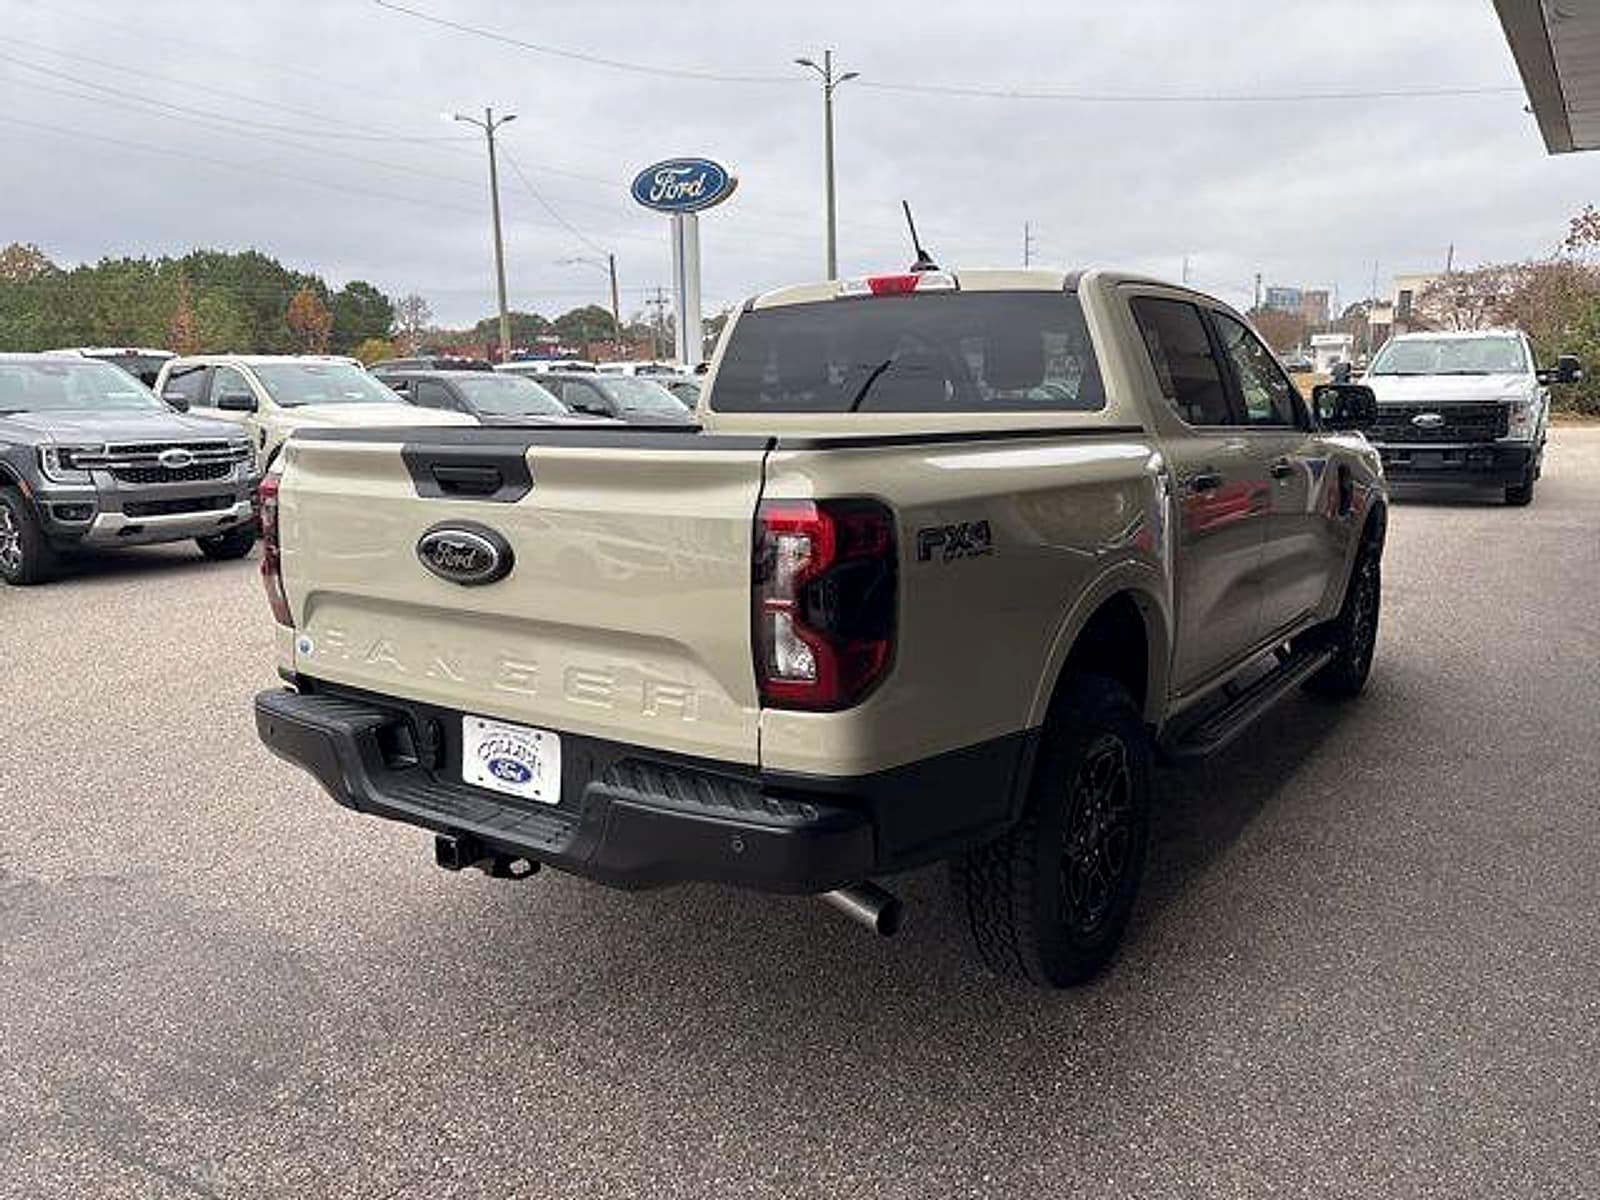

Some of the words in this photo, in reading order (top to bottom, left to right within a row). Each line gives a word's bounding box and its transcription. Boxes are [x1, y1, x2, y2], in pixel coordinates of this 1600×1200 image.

[650, 167, 707, 201] Ford
[433, 540, 478, 569] Ford
[917, 520, 992, 561] FX4
